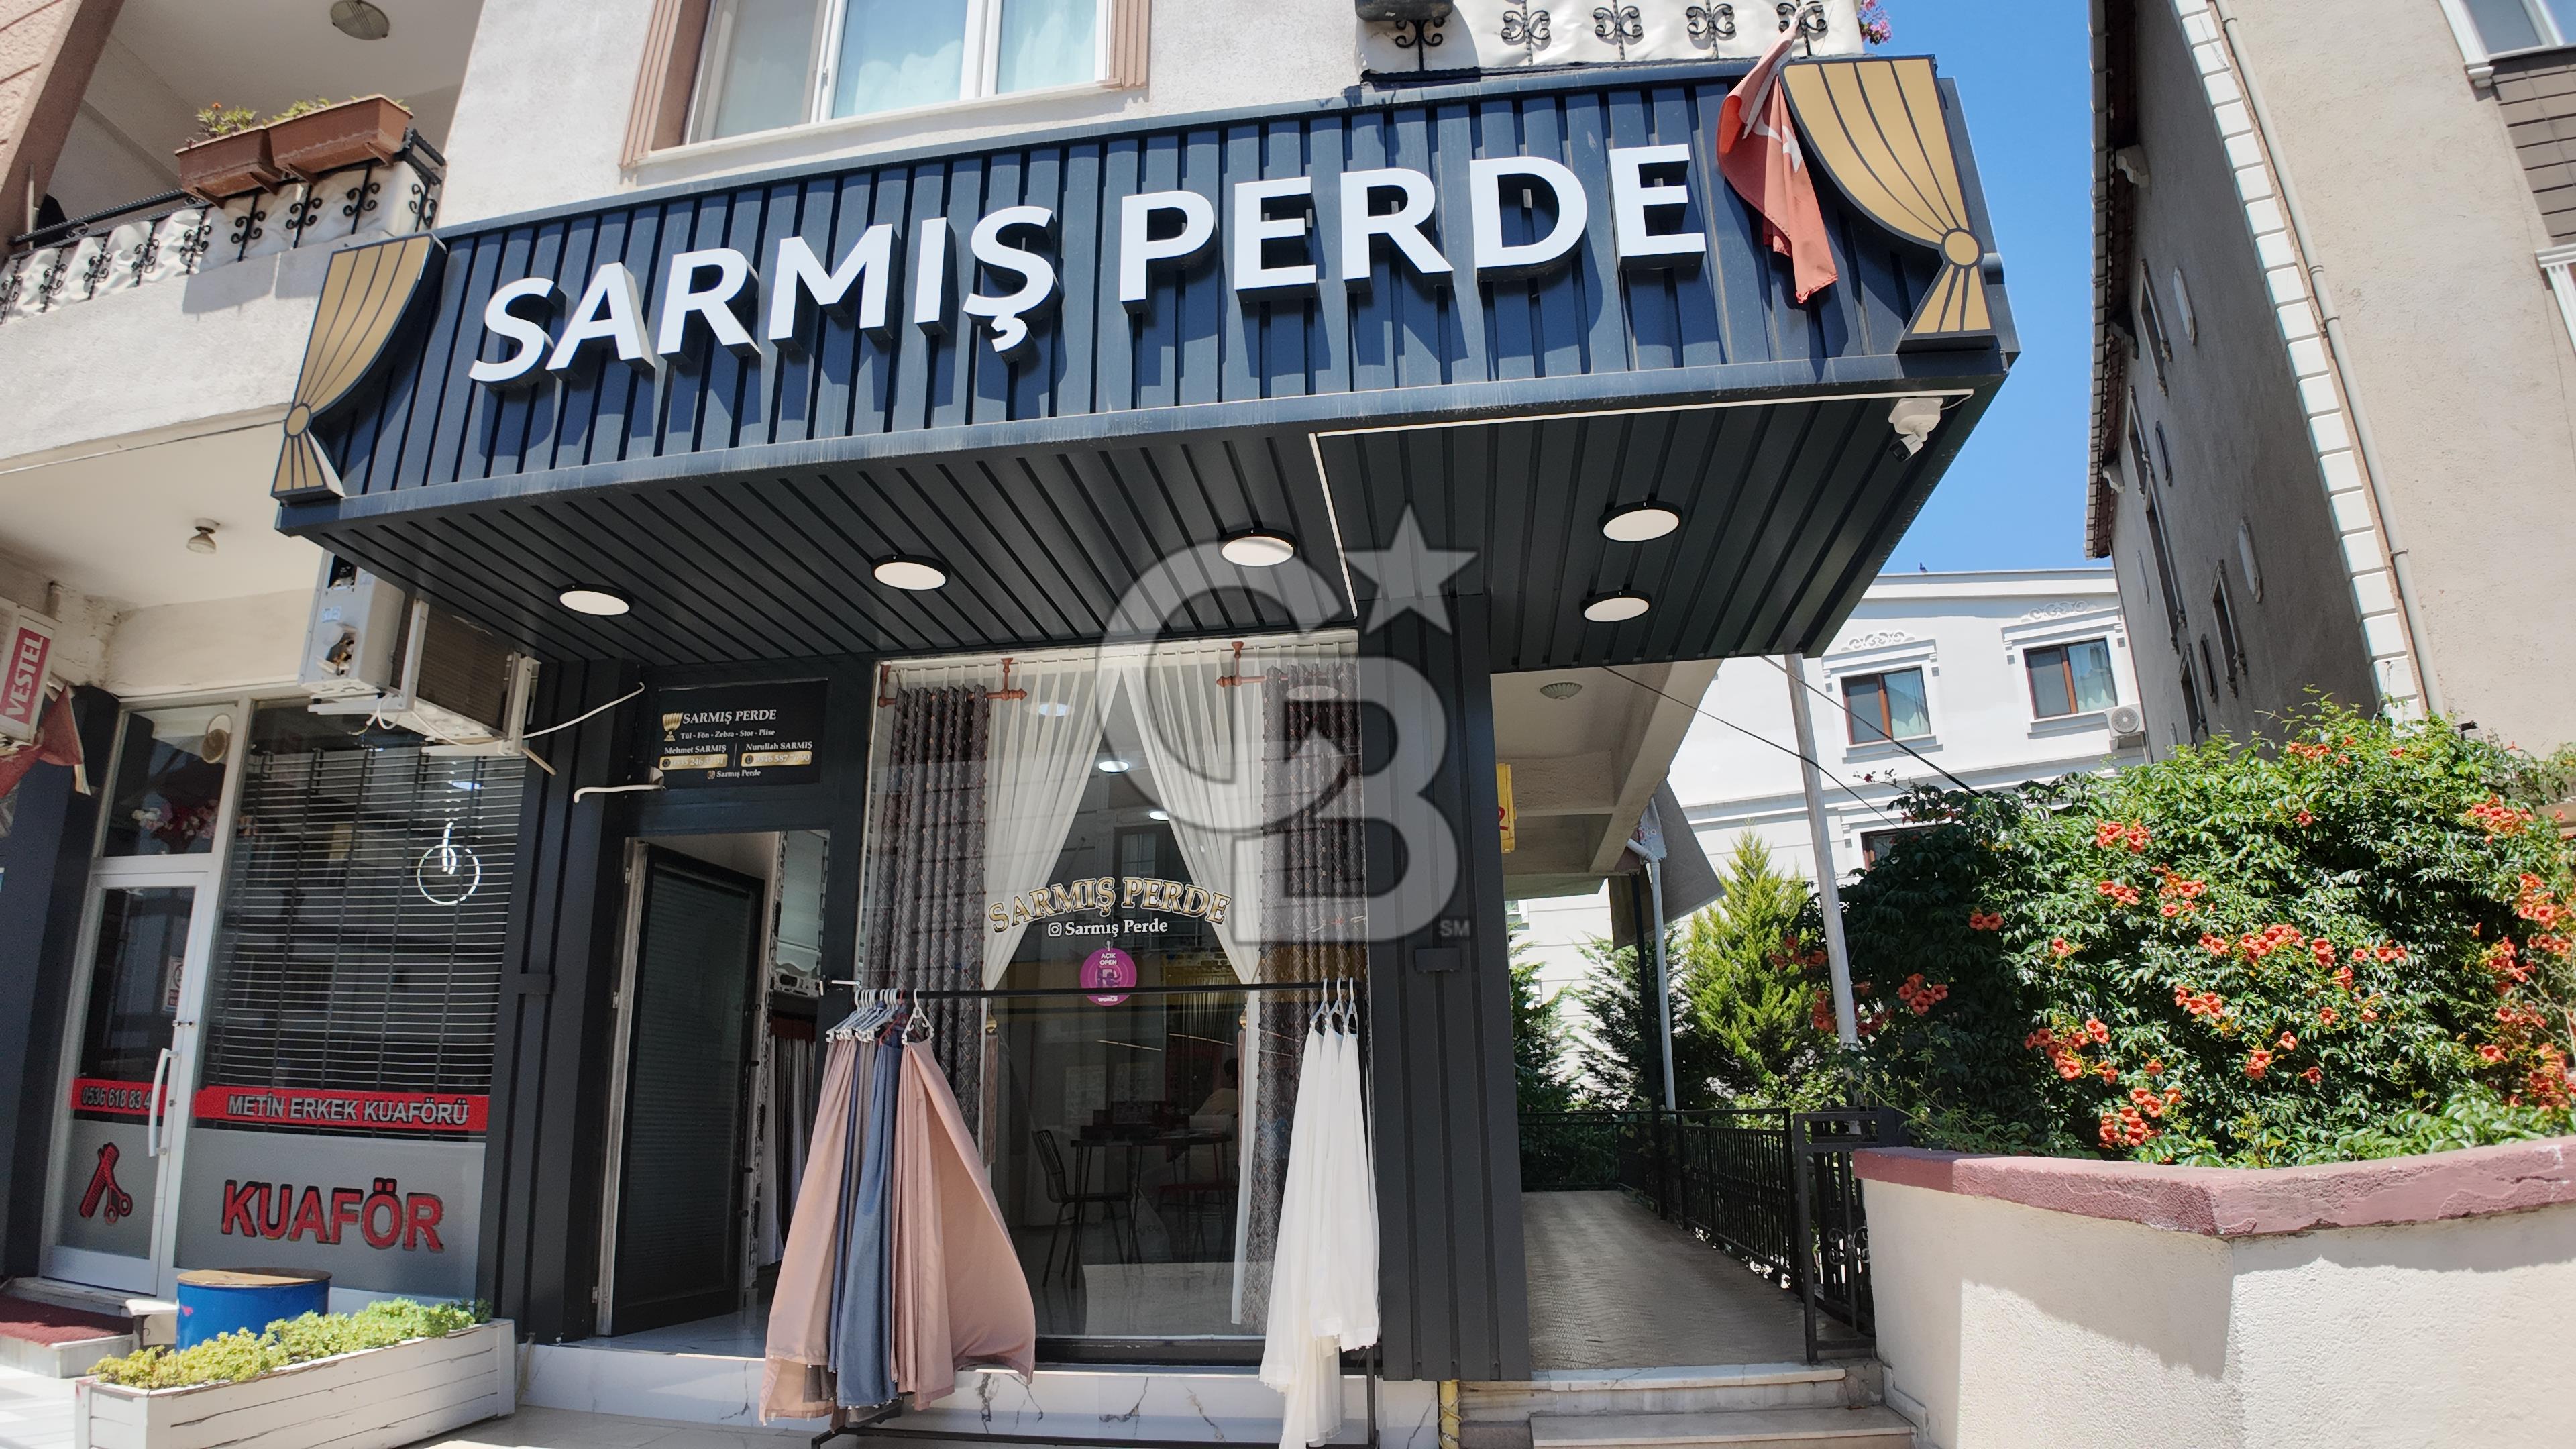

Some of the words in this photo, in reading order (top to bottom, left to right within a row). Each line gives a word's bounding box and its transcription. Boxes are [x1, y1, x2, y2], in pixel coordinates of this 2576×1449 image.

[468, 205, 1057, 385] SARMIŞ
[1119, 143, 1706, 307] PERDE
[5, 637, 44, 716] VESTEL
[682, 711, 733, 724] SARMIŞ
[735, 709, 777, 722] PERDE
[714, 730, 734, 738] Zebra
[739, 729, 753, 737] Stor
[664, 746, 694, 754] Mehmet
[694, 744, 727, 753] SARMIŞ
[745, 743, 779, 751] Nurullah
[780, 741, 813, 750] SARMIŞ
[690, 757, 704, 765] 246
[773, 754, 789, 763] 587
[716, 770, 740, 778] Sarmış
[741, 769, 761, 777] Perde
[987, 877, 1116, 934] SARMIŞ
[1121, 877, 1232, 925] PERDE
[1065, 921, 1119, 938] Sarmış
[1123, 919, 1168, 934] Perde
[82, 1086, 105, 1106] 0536
[108, 1088, 127, 1108] 618
[128, 1089, 142, 1110] 83
[144, 1091, 153, 1110] 4
[227, 1093, 285, 1118] METİN
[289, 1097, 360, 1121] ERKEK
[363, 1097, 470, 1126] KUAFÖRÜ
[221, 1177, 445, 1253] KUAFÖR
